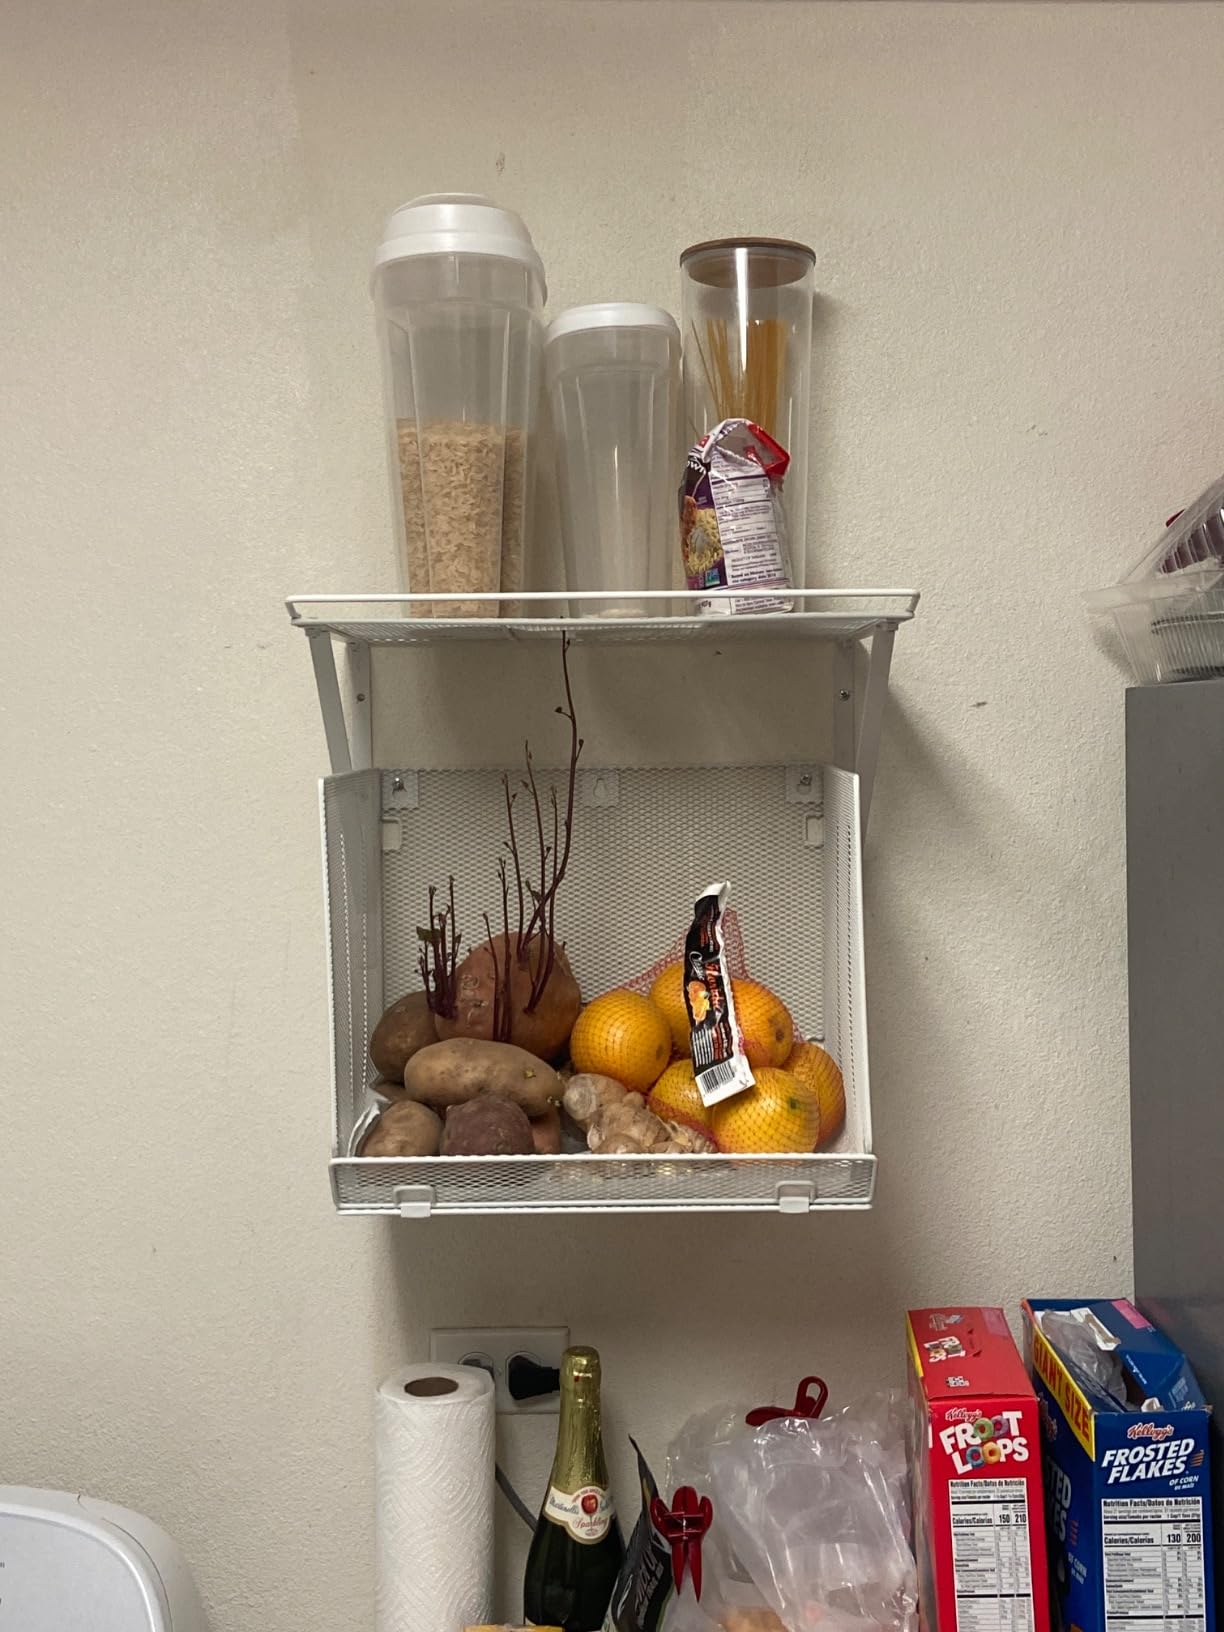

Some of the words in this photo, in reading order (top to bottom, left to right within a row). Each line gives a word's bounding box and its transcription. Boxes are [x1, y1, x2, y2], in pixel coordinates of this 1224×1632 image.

[945, 1407, 982, 1422] Kellogg's
[1065, 1382, 1090, 1442] SIZE
[939, 1411, 1022, 1455] FROOT
[1127, 1423, 1174, 1441] Kellogg's
[952, 1437, 1029, 1475] LOOPS
[1101, 1438, 1195, 1468] FROSTED
[1107, 1457, 1187, 1484] FLAKES
[1169, 1478, 1178, 1486] OF
[1180, 1475, 1199, 1484] CORN
[999, 1513, 1010, 1523] 150
[1015, 1513, 1026, 1523] 210
[1167, 1533, 1181, 1543] 130
[1187, 1533, 1200, 1543] 200
